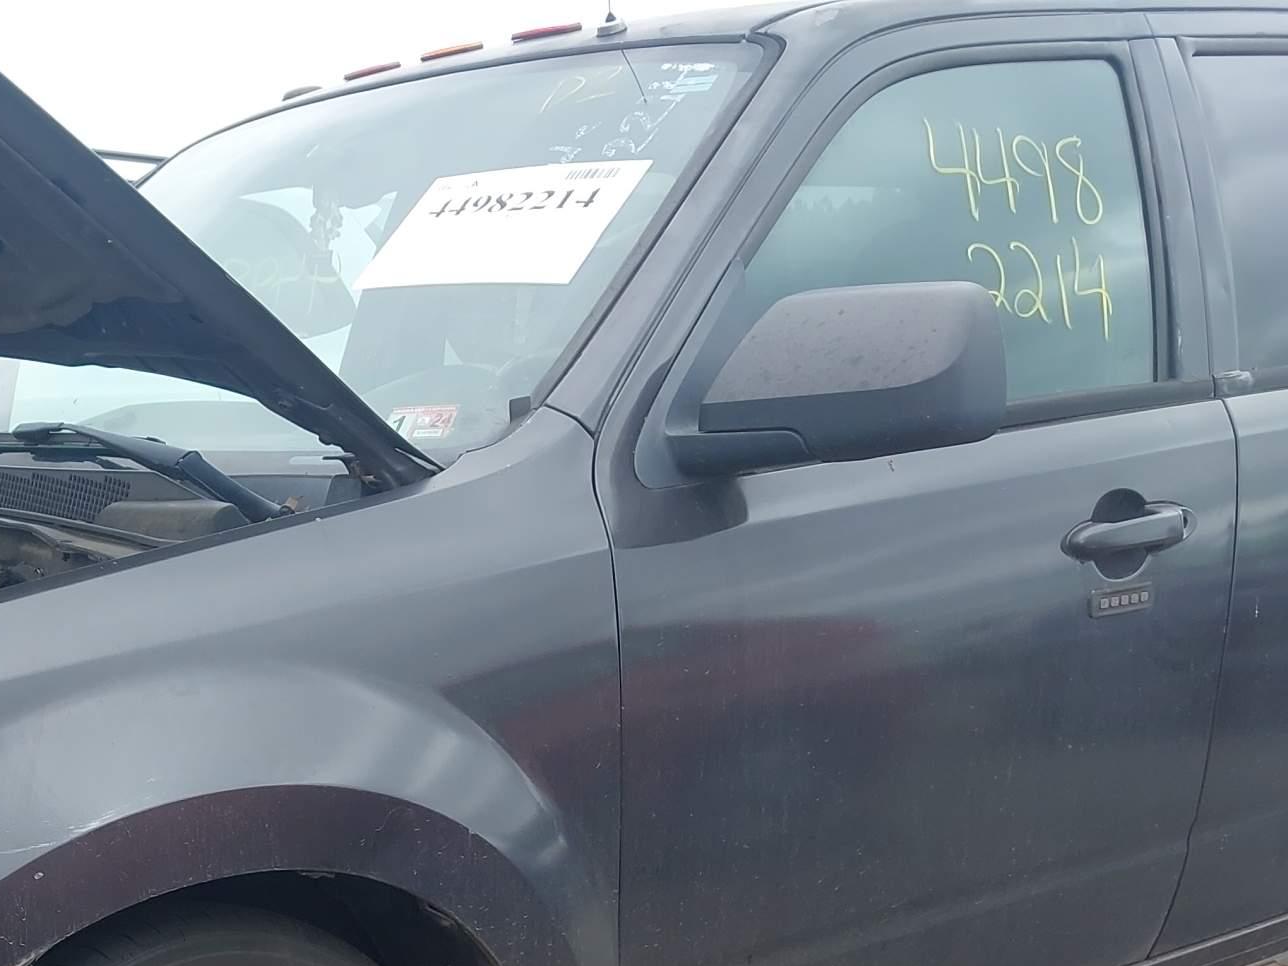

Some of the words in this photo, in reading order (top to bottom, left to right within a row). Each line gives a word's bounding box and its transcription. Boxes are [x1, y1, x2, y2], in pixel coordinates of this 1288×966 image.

[429, 187, 601, 218] 44982214
[923, 117, 1103, 226] 4498
[967, 236, 1113, 341] 2214
